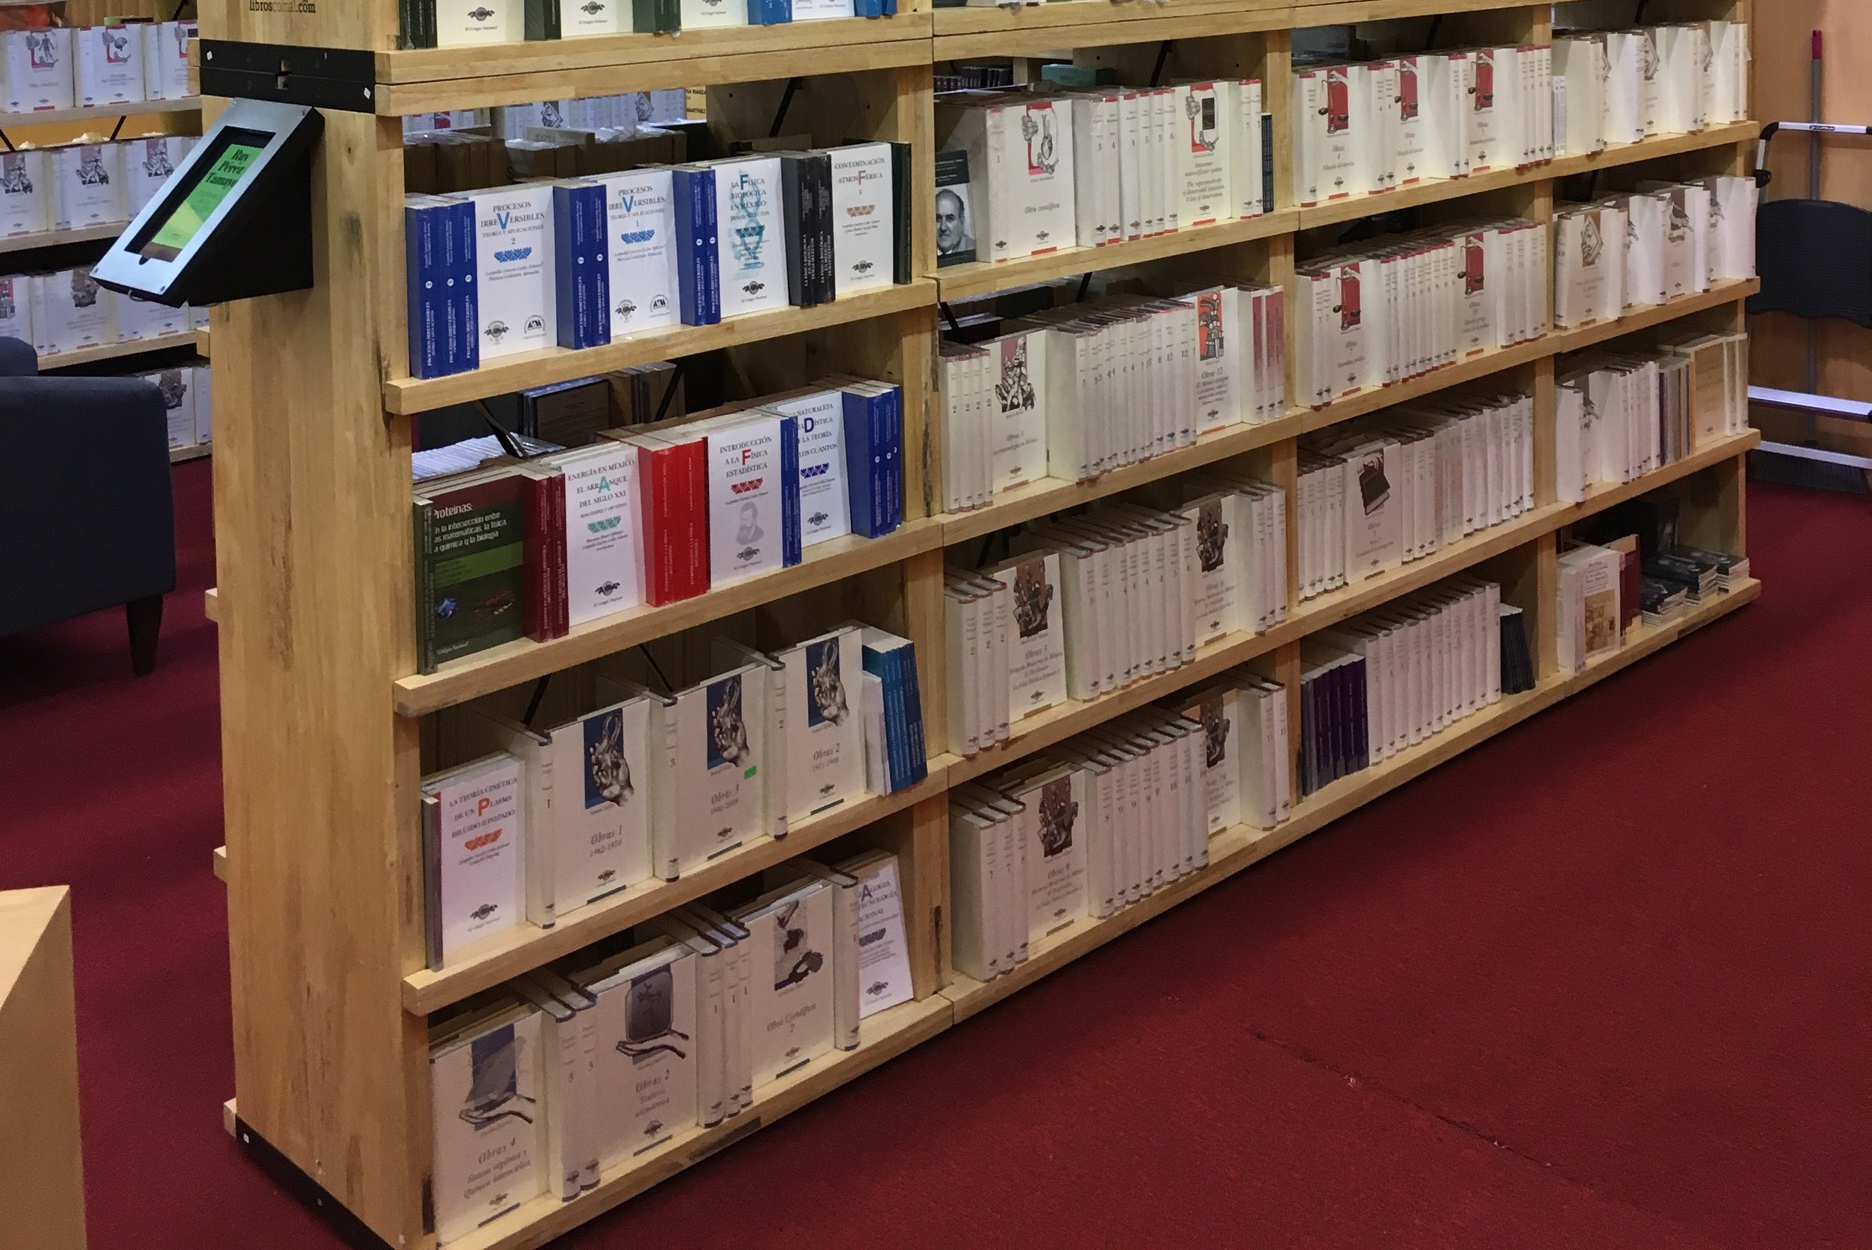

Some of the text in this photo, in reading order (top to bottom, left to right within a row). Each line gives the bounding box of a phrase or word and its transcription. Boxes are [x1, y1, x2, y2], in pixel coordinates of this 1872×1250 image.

[618, 186, 653, 196] PROCESOS
[493, 201, 532, 212] PROCESOS
[480, 212, 545, 230] IRREVERSIBLES
[719, 436, 772, 454] INTRODUCCIÓN
[568, 469, 597, 481] ENERGÍA
[726, 462, 768, 478] ESTADÍSTICA
[579, 499, 592, 508] DEL
[593, 494, 613, 505] SIGLO
